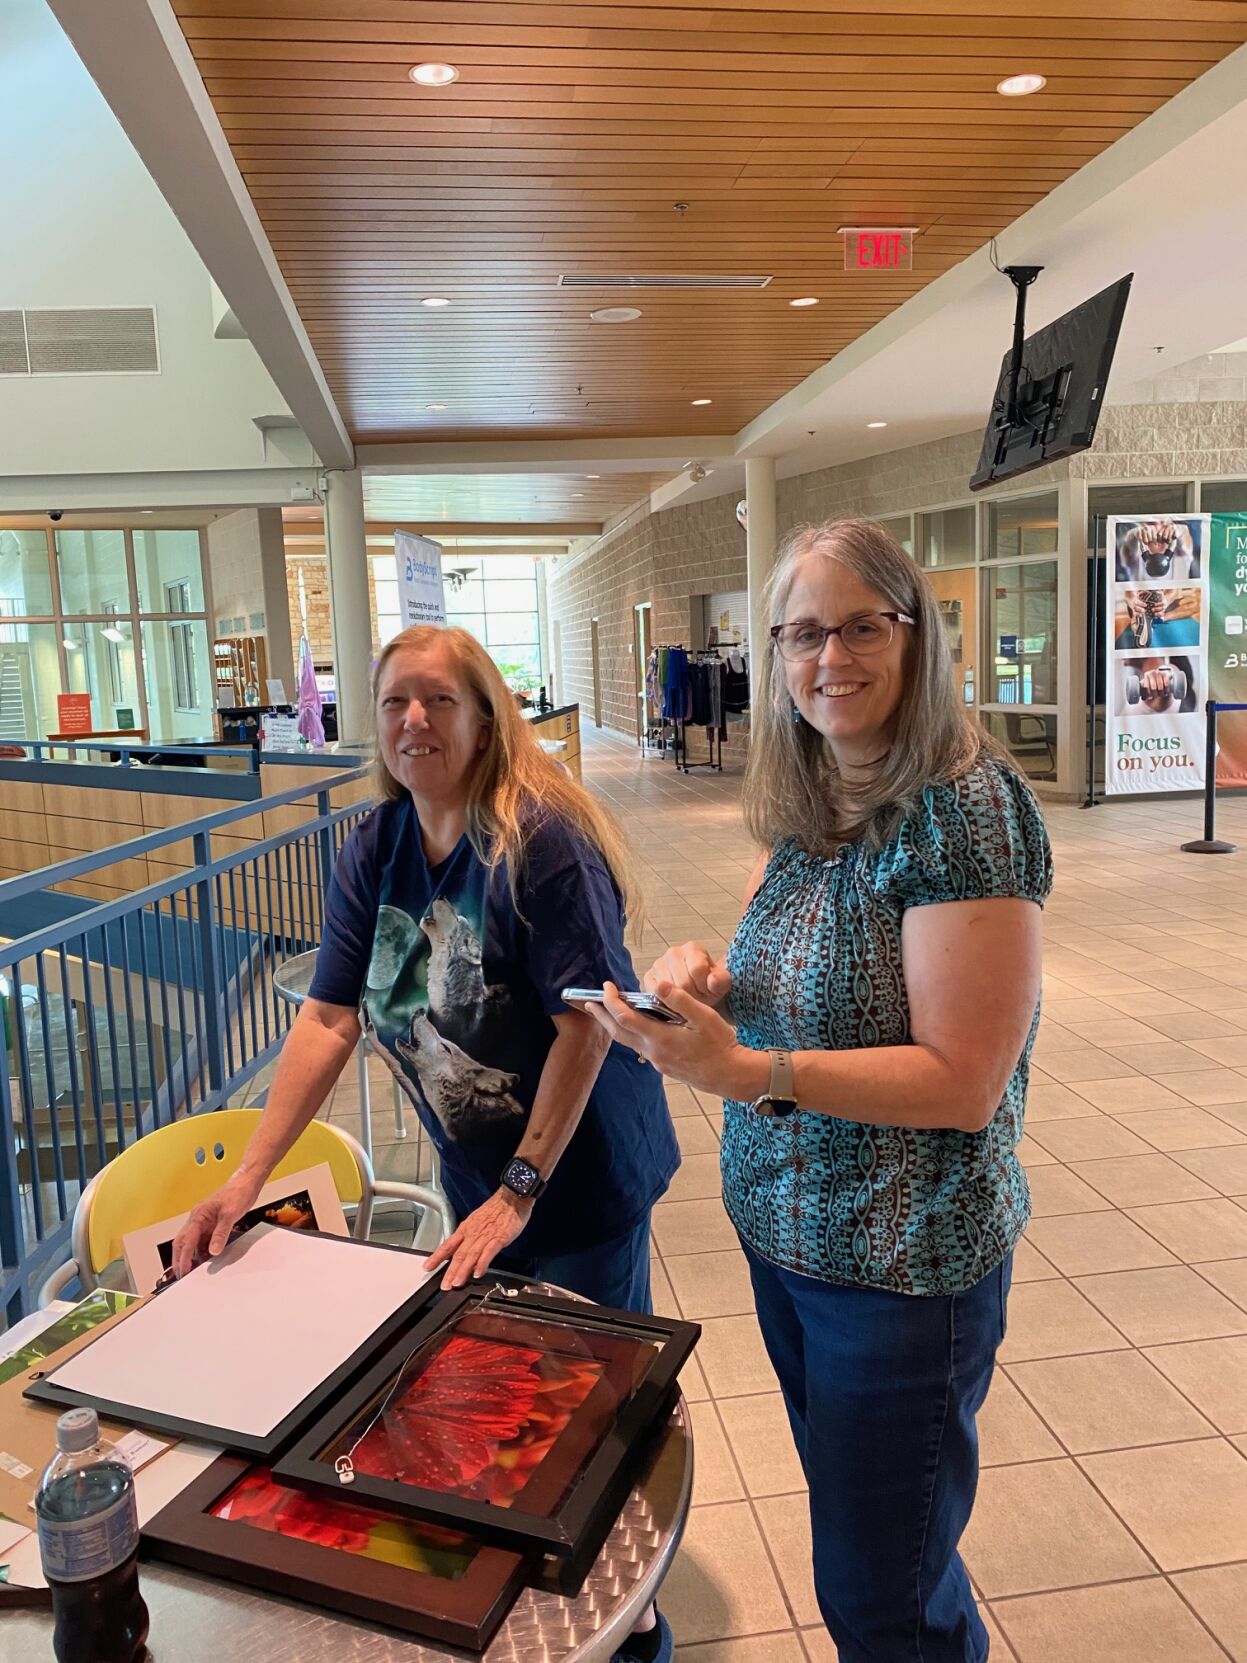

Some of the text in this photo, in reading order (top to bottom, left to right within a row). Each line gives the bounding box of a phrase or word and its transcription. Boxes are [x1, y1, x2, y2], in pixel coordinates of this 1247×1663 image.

[859, 234, 902, 267] EXIT
[1117, 733, 1181, 753] Focus
[1117, 753, 1195, 773] on you.
